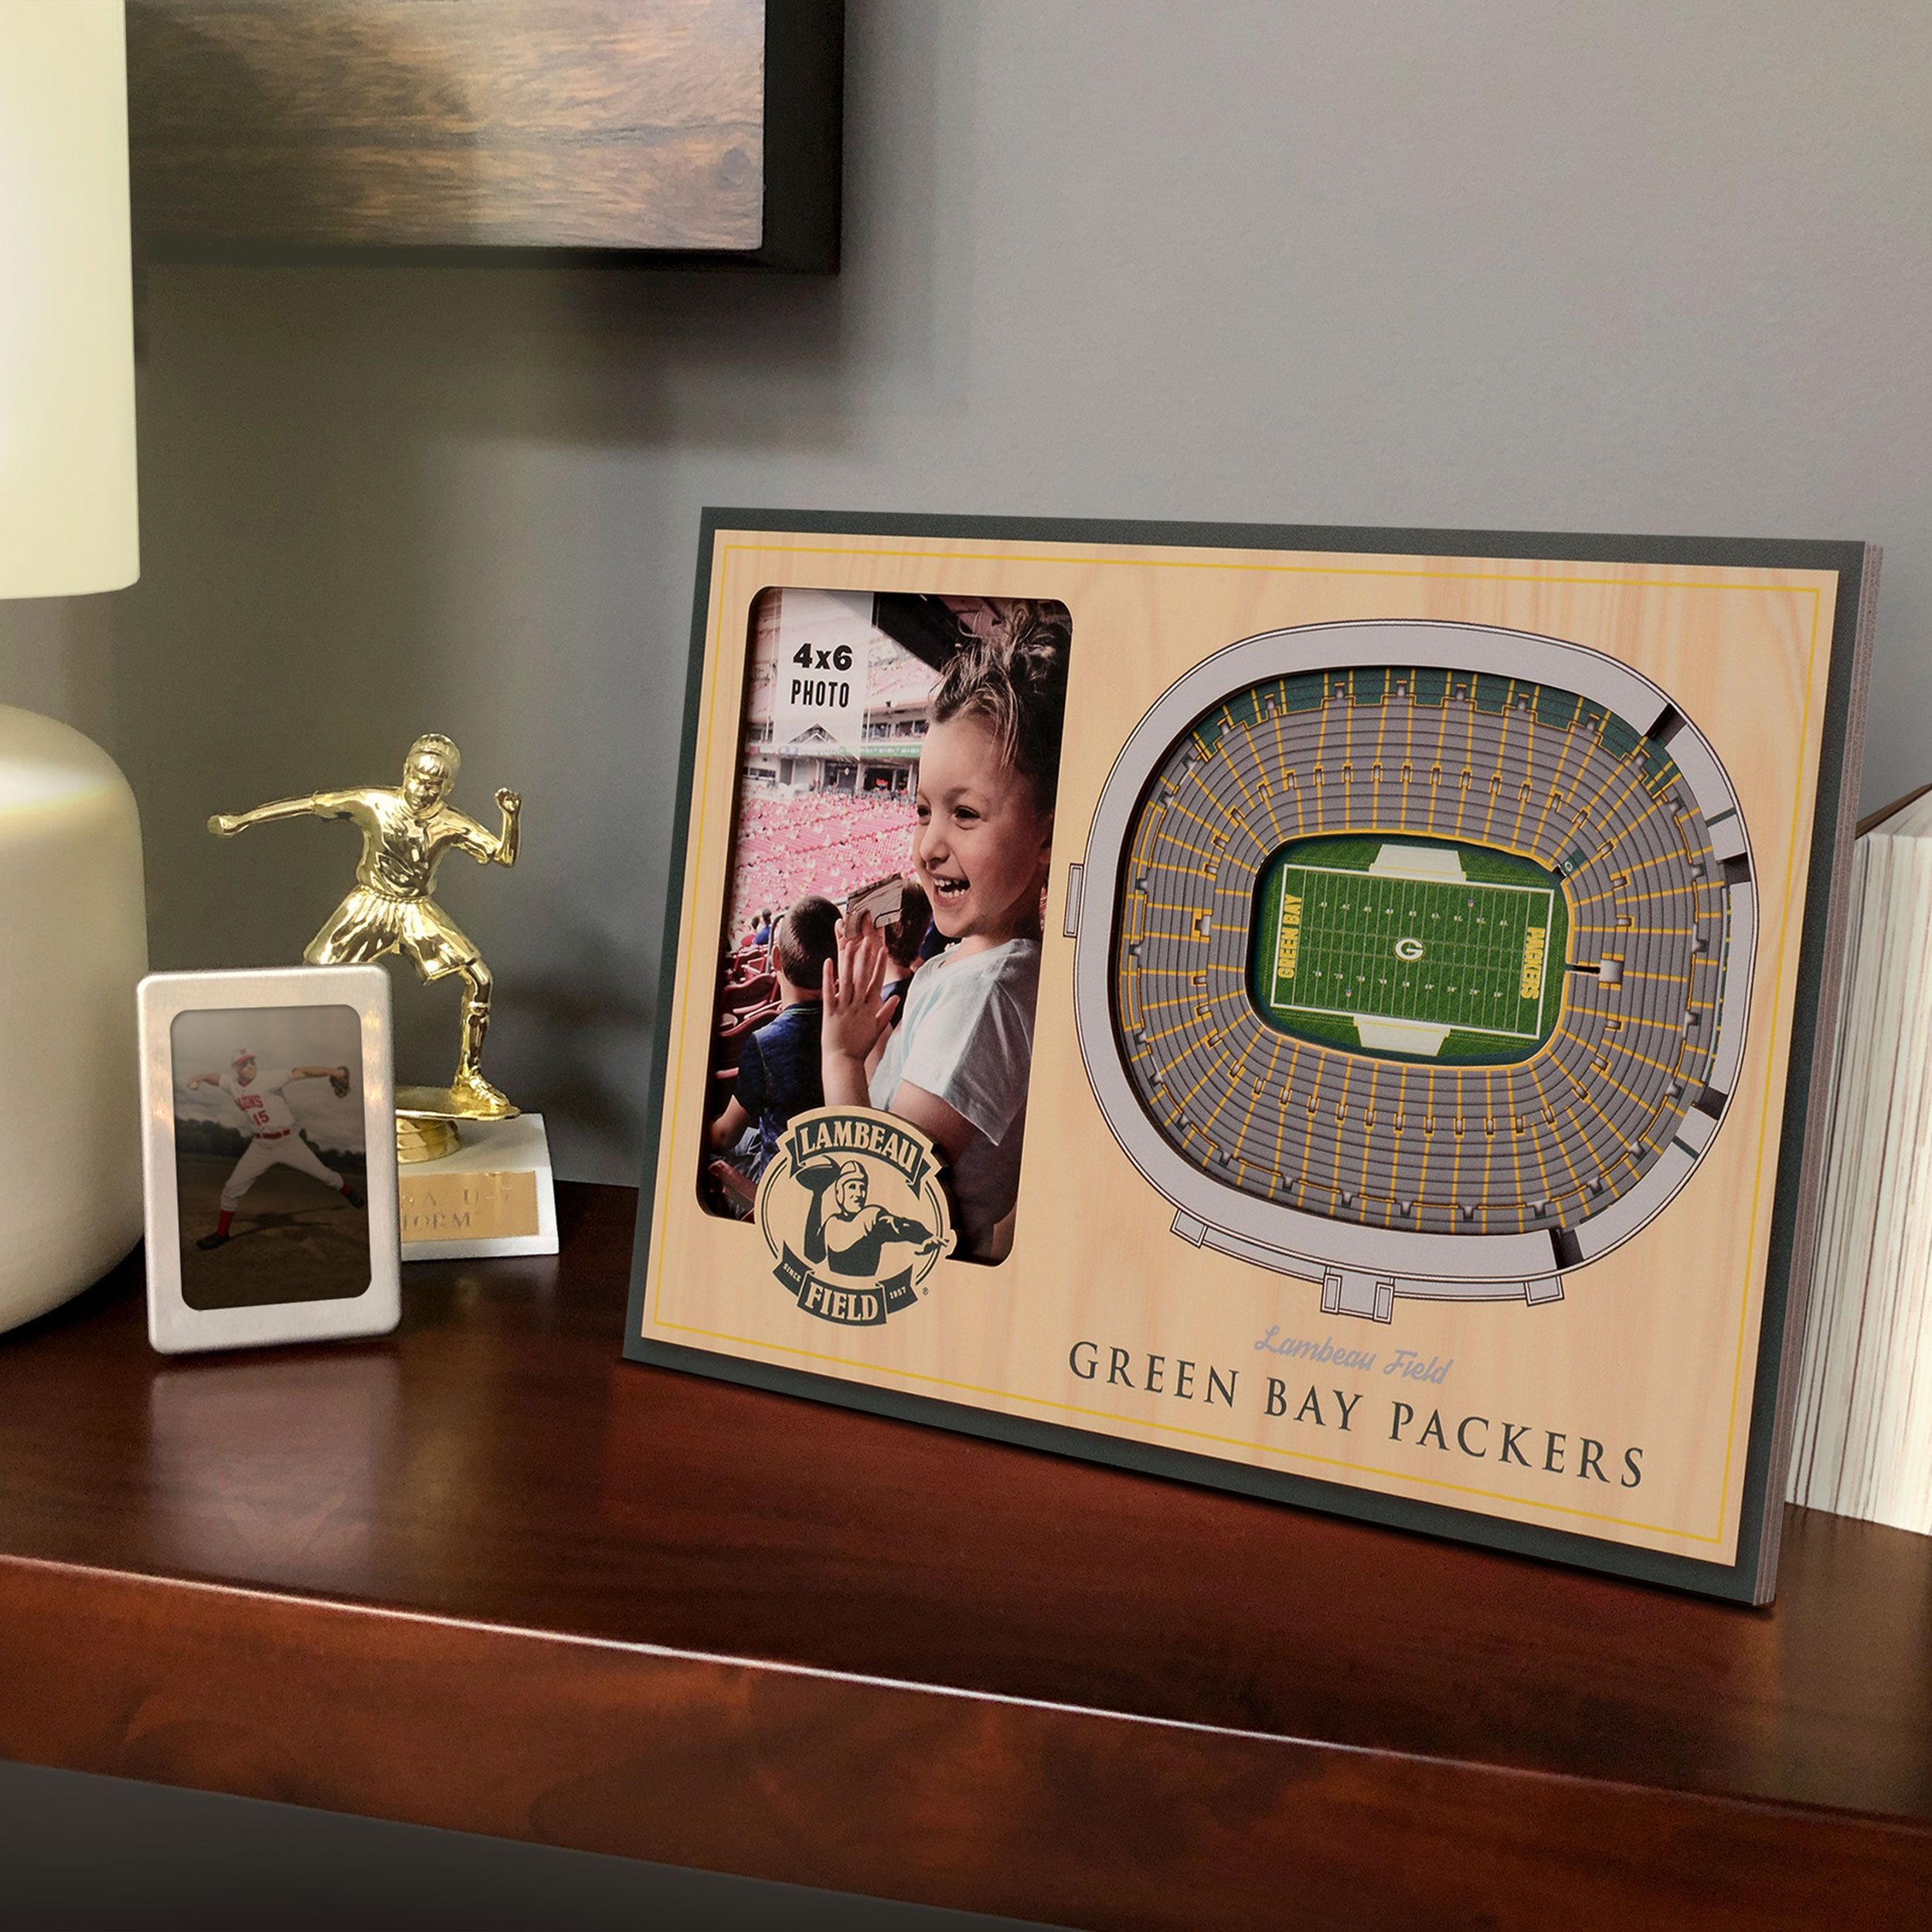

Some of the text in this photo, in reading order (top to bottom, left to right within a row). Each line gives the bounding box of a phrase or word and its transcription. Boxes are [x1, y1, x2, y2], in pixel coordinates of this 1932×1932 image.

[793, 643, 852, 671] 4x6
[791, 679, 849, 708] PHOTO
[1277, 893, 1302, 979] GREEN BAY
[1394, 937, 1426, 962] G
[1521, 927, 1546, 1000] PACKERS
[252, 1110, 269, 1125] 15
[799, 1121, 918, 1173] LAMBEAU
[782, 1263, 802, 1282] SINCE
[804, 1281, 879, 1321] FIELD
[889, 1286, 907, 1300] 1957
[1253, 1325, 1454, 1386] Lambeau Field
[1068, 1340, 1644, 1489] GREEN BAY PACKERS
